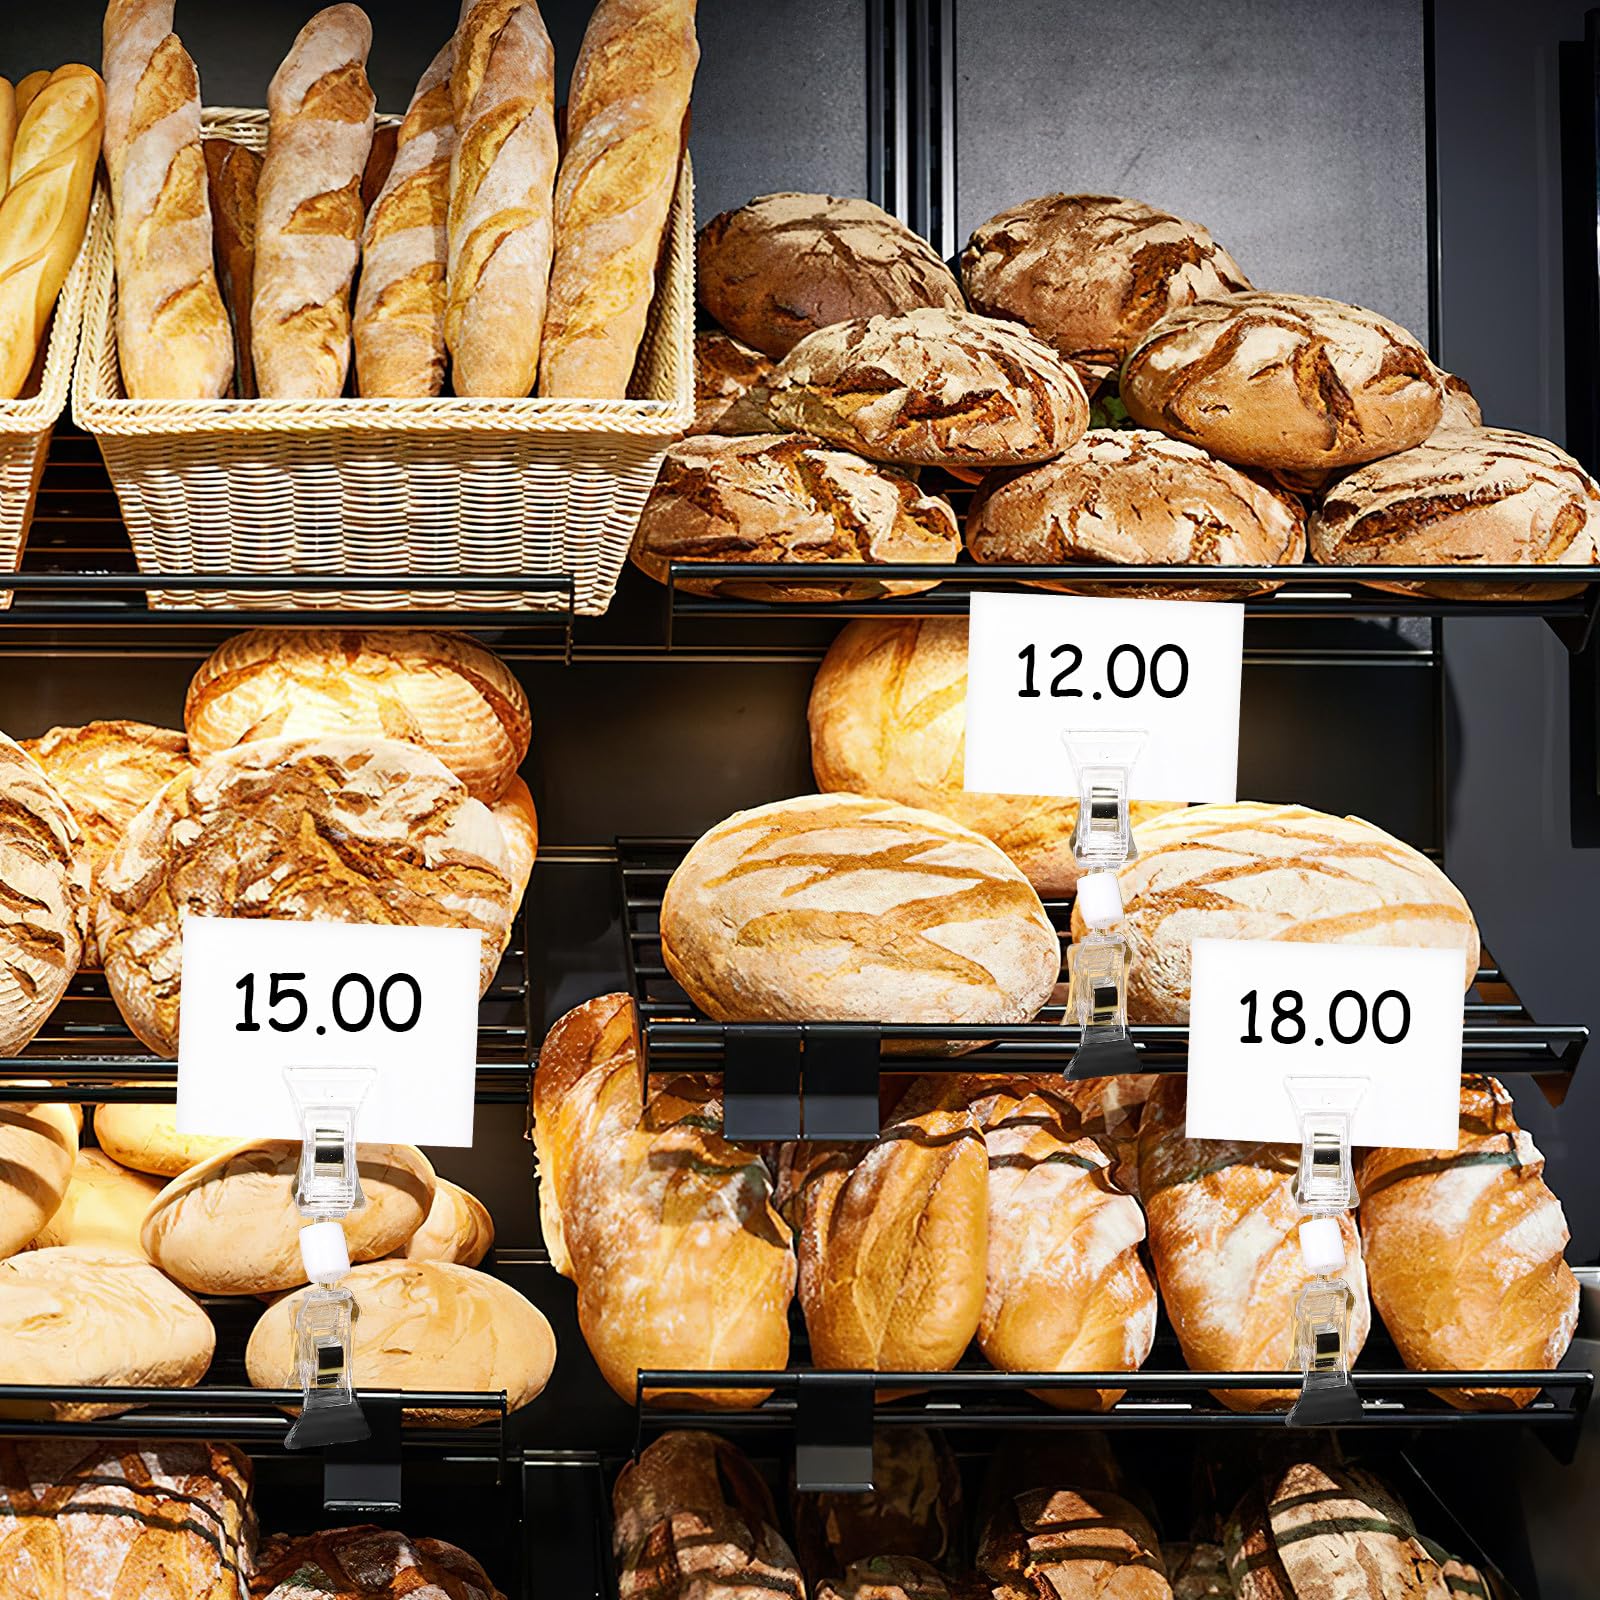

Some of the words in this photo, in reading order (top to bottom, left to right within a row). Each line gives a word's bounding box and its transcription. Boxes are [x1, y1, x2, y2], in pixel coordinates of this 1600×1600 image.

[1018, 643, 1189, 701] 12.00
[235, 972, 422, 1036] 15.00
[1240, 989, 1411, 1047] 18.00
